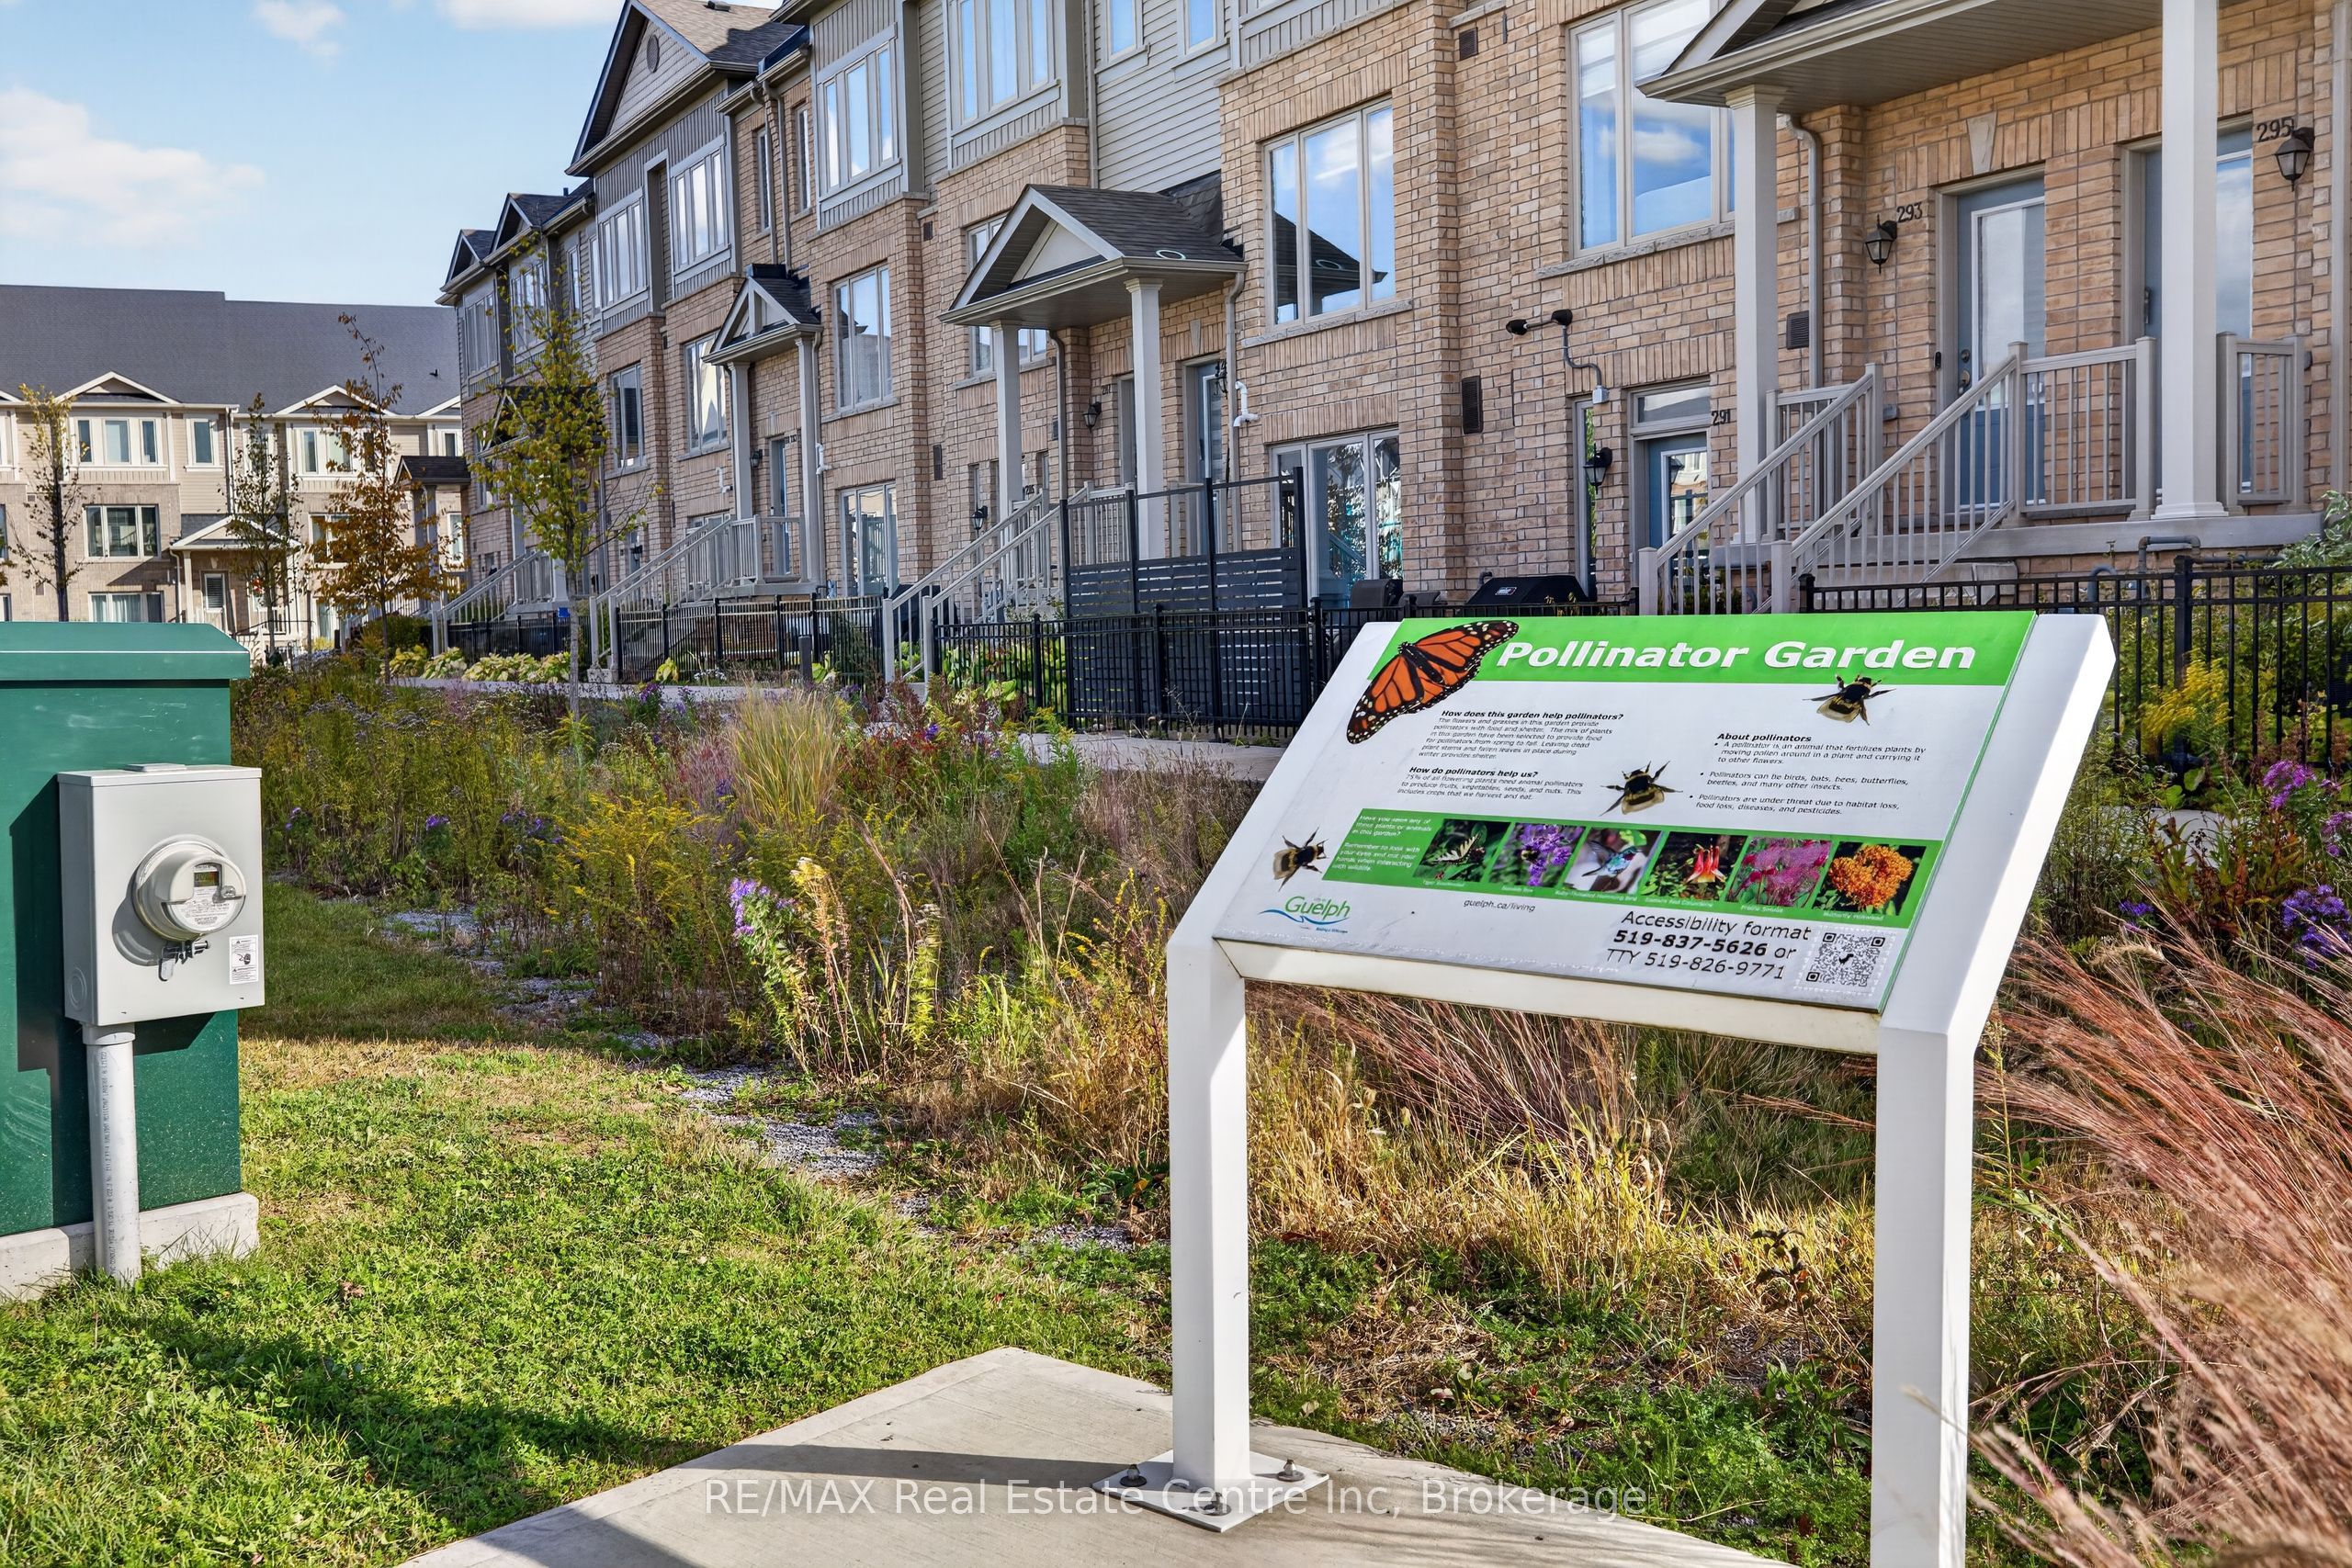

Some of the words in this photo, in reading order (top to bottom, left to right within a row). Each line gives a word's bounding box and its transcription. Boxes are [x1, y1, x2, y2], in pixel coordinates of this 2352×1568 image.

[2256, 116, 2294, 142] 295
[1896, 201, 1923, 223] 293
[1712, 409, 1731, 425] 291
[1496, 640, 1750, 669] Pollinator
[1764, 639, 1976, 669] Garden
[1752, 734, 1812, 742] pollinators
[1915, 746, 1926, 754] by
[1445, 768, 1496, 776] pollinators
[1498, 770, 1518, 778] help
[1709, 771, 1751, 779] Pollinators
[1784, 773, 1807, 782] birds,
[1860, 776, 1908, 785] butterflies,
[1699, 794, 1741, 802] Pollinators
[1846, 800, 1877, 808] habitat
[1880, 802, 1900, 810] loss,
[1738, 804, 1776, 812] diseases,
[1797, 807, 1842, 815] pesticides.
[1285, 896, 1351, 920] Guelph
[1464, 899, 1536, 912] guelph.ca/living
[1622, 910, 1737, 936] Accessibility
[1743, 921, 1812, 941] format
[1613, 930, 1768, 957] 519-837-5626
[1774, 947, 1797, 959] or
[1607, 948, 1641, 964] TTY
[1644, 952, 1785, 980] 519-826-9771
